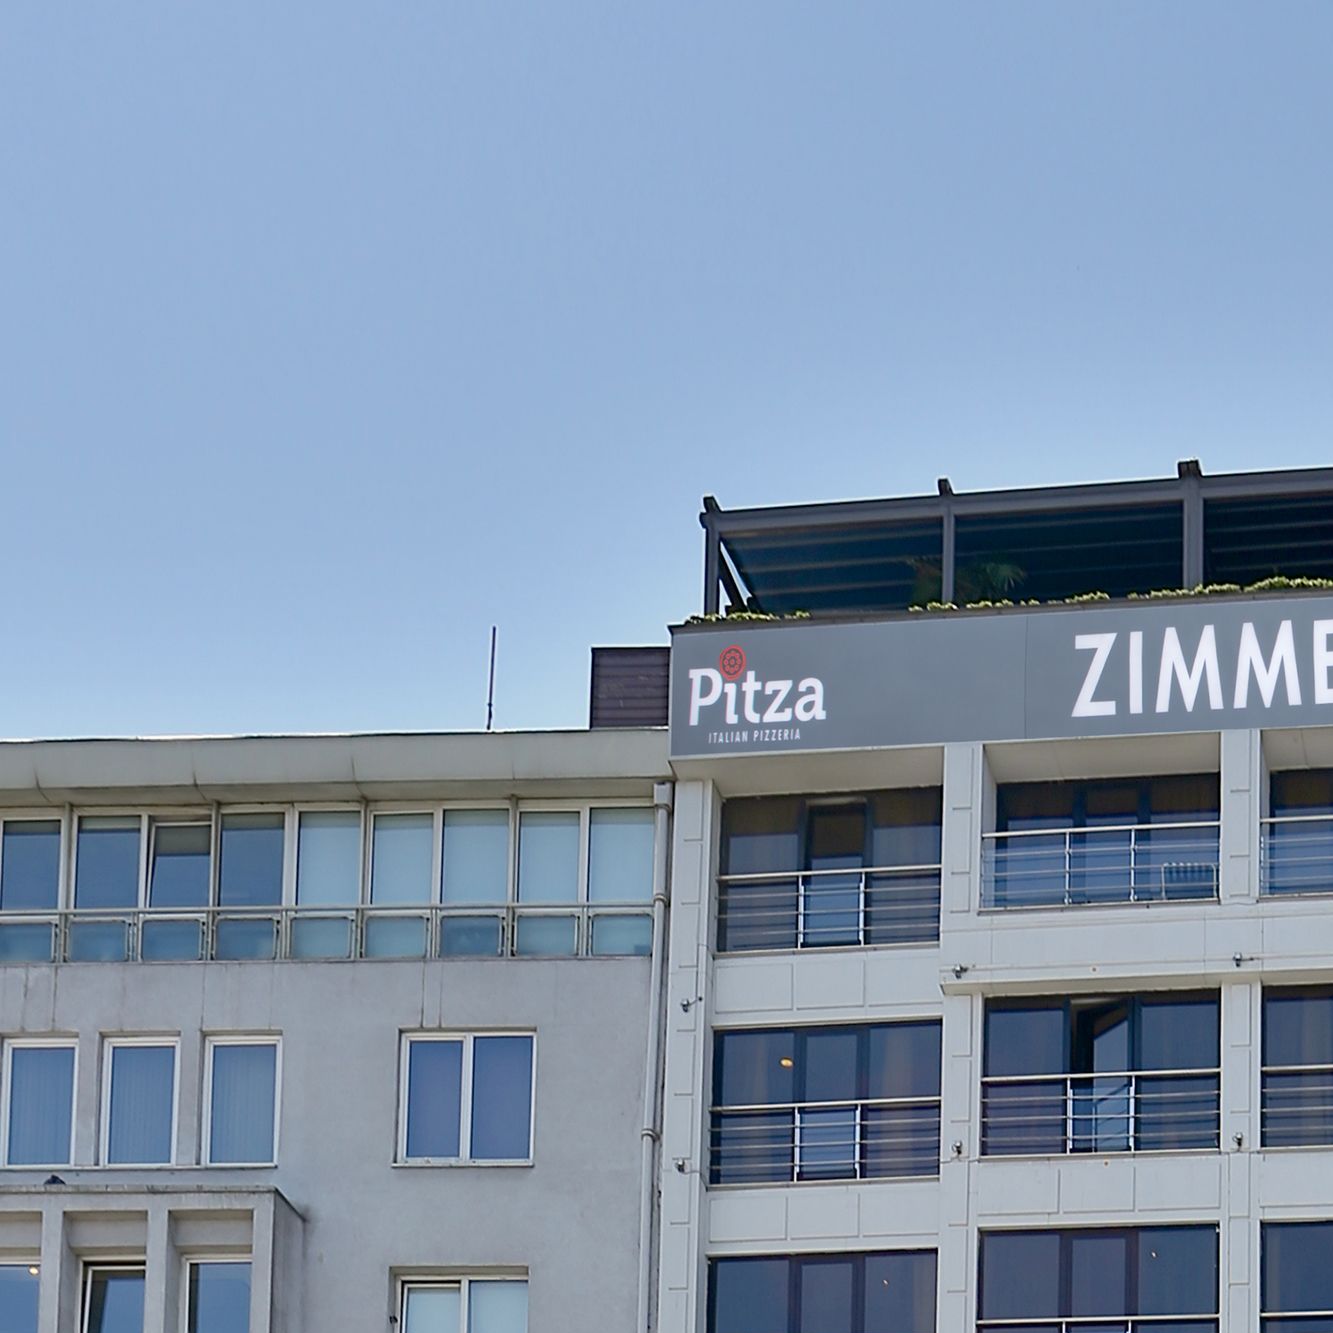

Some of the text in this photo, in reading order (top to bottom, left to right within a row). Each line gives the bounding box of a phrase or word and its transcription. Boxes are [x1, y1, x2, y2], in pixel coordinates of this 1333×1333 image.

[689, 645, 826, 726] Pitza
[708, 728, 801, 744] ITALIAN PIZZERIA
